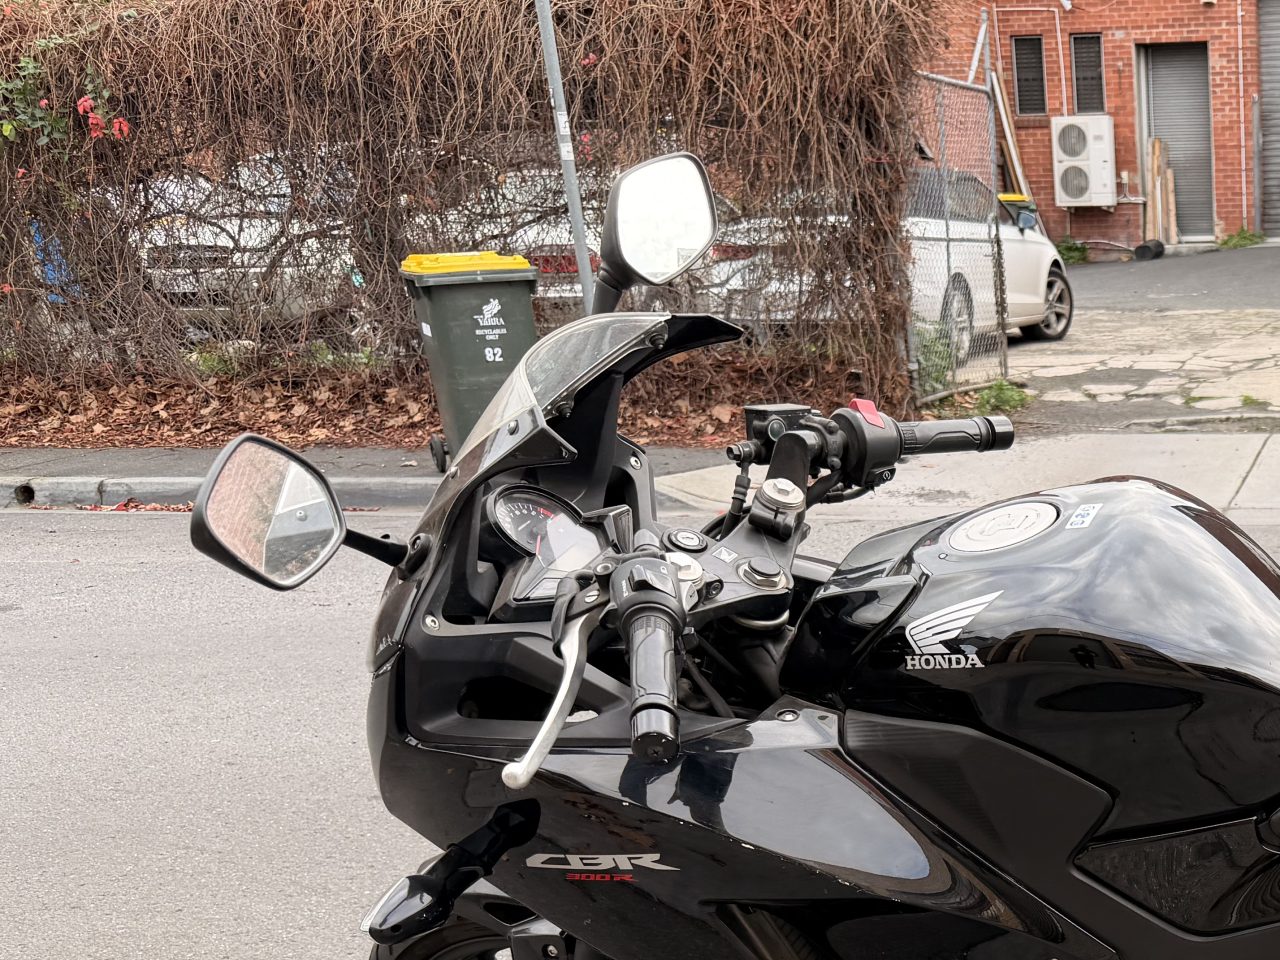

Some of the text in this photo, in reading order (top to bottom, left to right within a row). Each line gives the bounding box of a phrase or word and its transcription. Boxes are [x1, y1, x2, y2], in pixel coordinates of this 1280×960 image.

[477, 317, 505, 326] YARRA
[484, 347, 504, 362] 82
[904, 654, 985, 670] HONDA
[525, 853, 681, 871] CBR
